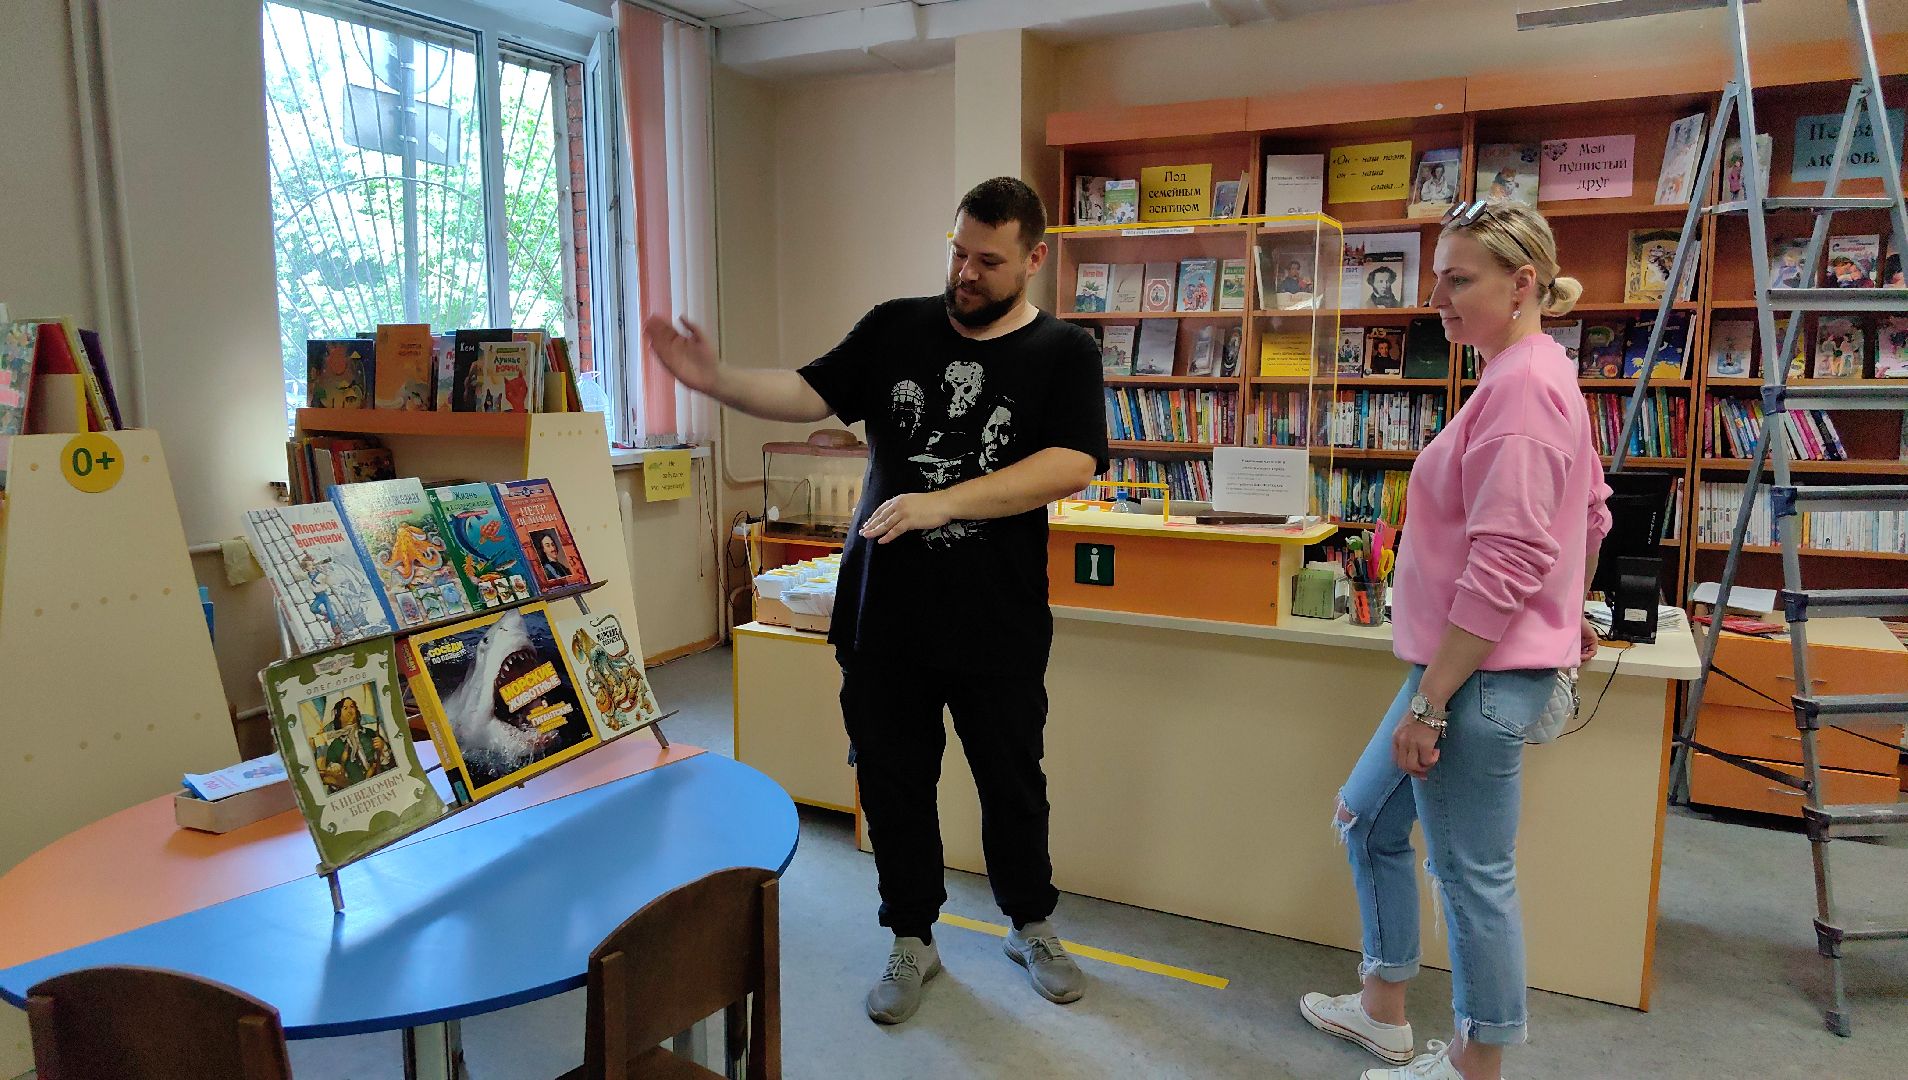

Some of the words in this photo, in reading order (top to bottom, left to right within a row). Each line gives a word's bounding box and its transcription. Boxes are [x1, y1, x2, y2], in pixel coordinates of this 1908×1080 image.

[1362, 155, 1379, 163] наш
[1558, 159, 1627, 174] пушистый
[1164, 171, 1187, 182] Под
[1576, 177, 1610, 192] друг
[1148, 187, 1201, 198] семейным
[1148, 203, 1200, 214] зонтиком
[460, 342, 475, 352] Кем
[72, 447, 115, 476] 0+
[519, 504, 547, 517] ПЕТР
[291, 519, 339, 536] Морской
[428, 641, 464, 657] СОСЕДИ
[306, 683, 333, 695] ОЛЕГ
[335, 671, 368, 688] ОРЛОВ
[500, 661, 556, 700] МОРСКИЕ
[508, 675, 562, 713] ЖИВОТНЫЕ
[339, 772, 405, 808] НЕВЕДОМЫМ
[348, 788, 399, 817] БЕРЕГАМ
